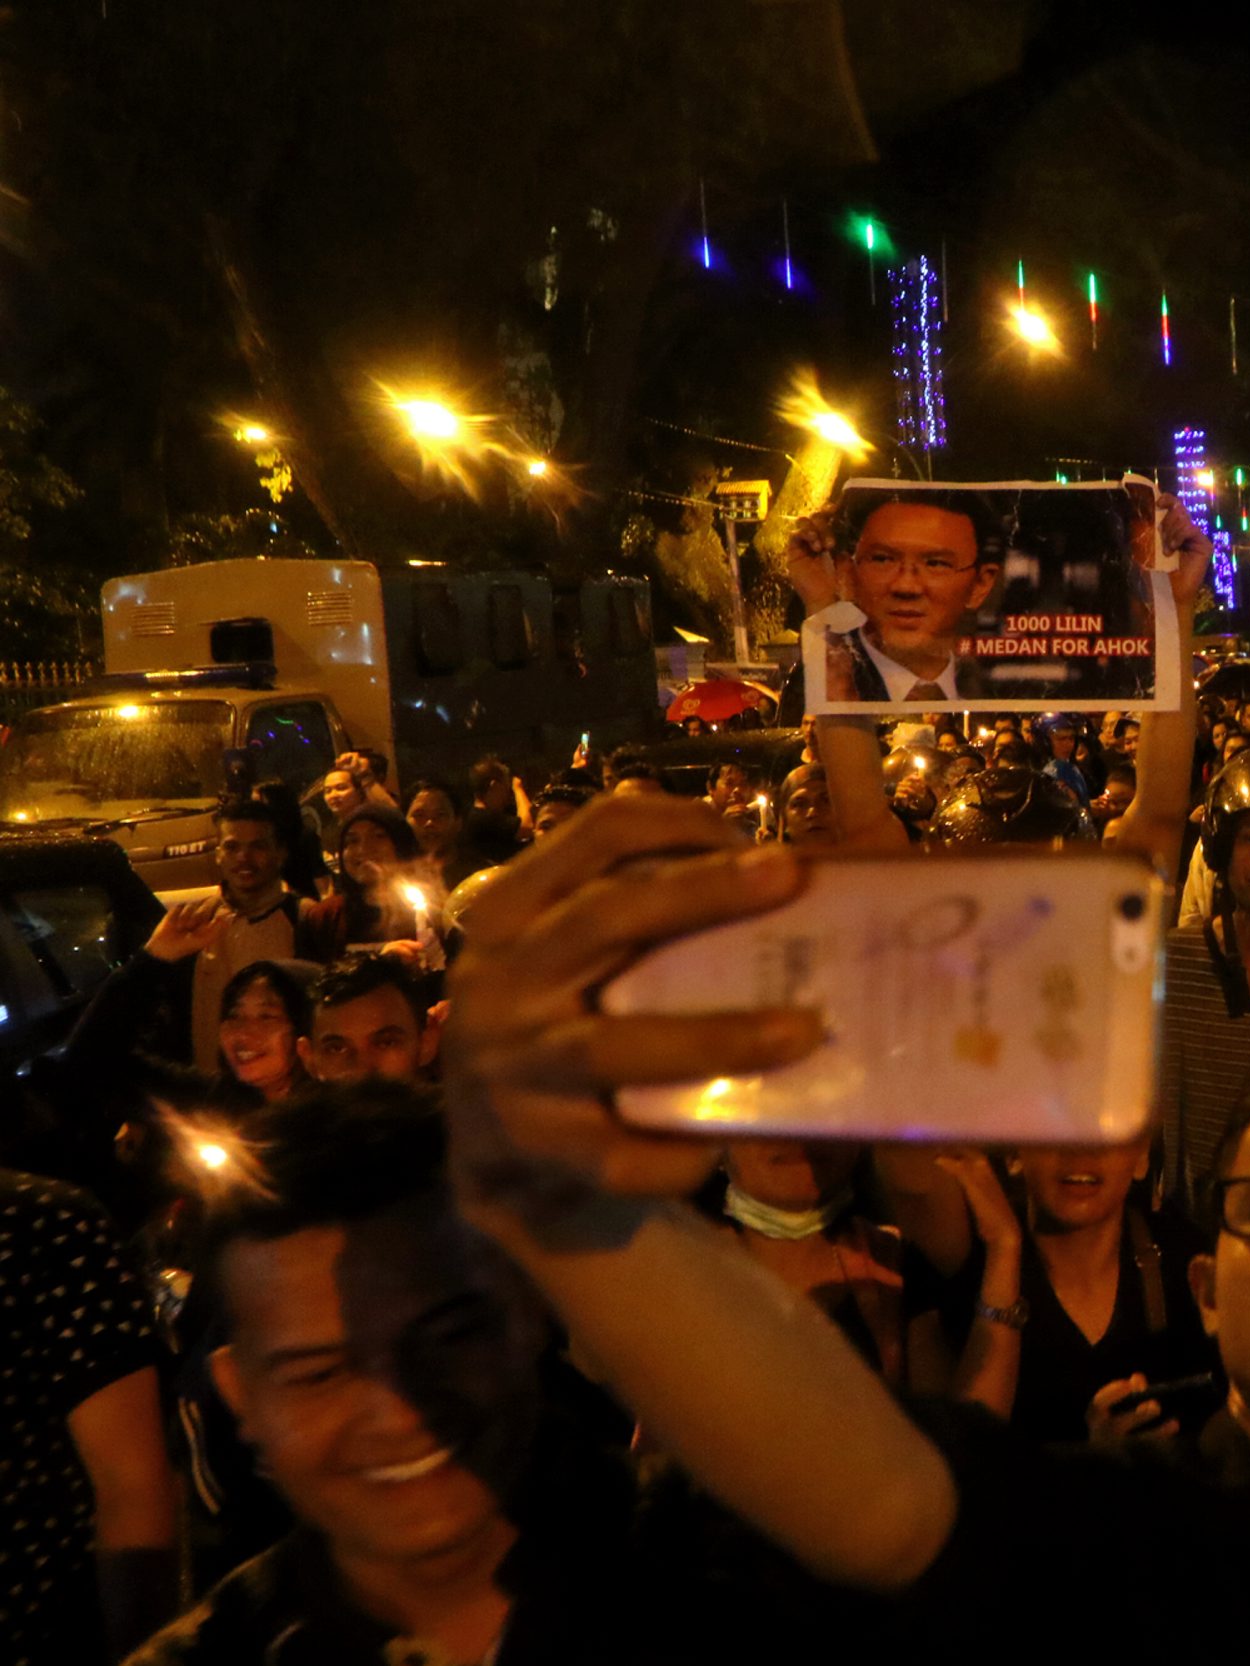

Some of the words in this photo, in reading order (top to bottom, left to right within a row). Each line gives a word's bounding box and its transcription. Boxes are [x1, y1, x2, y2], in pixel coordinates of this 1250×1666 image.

[1006, 616, 1050, 632] 1000
[1055, 616, 1101, 632] LILIN
[960, 640, 971, 654] #
[976, 639, 1047, 655] MEDAN
[1052, 639, 1089, 655] FOR
[1093, 639, 1149, 655] AHOK
